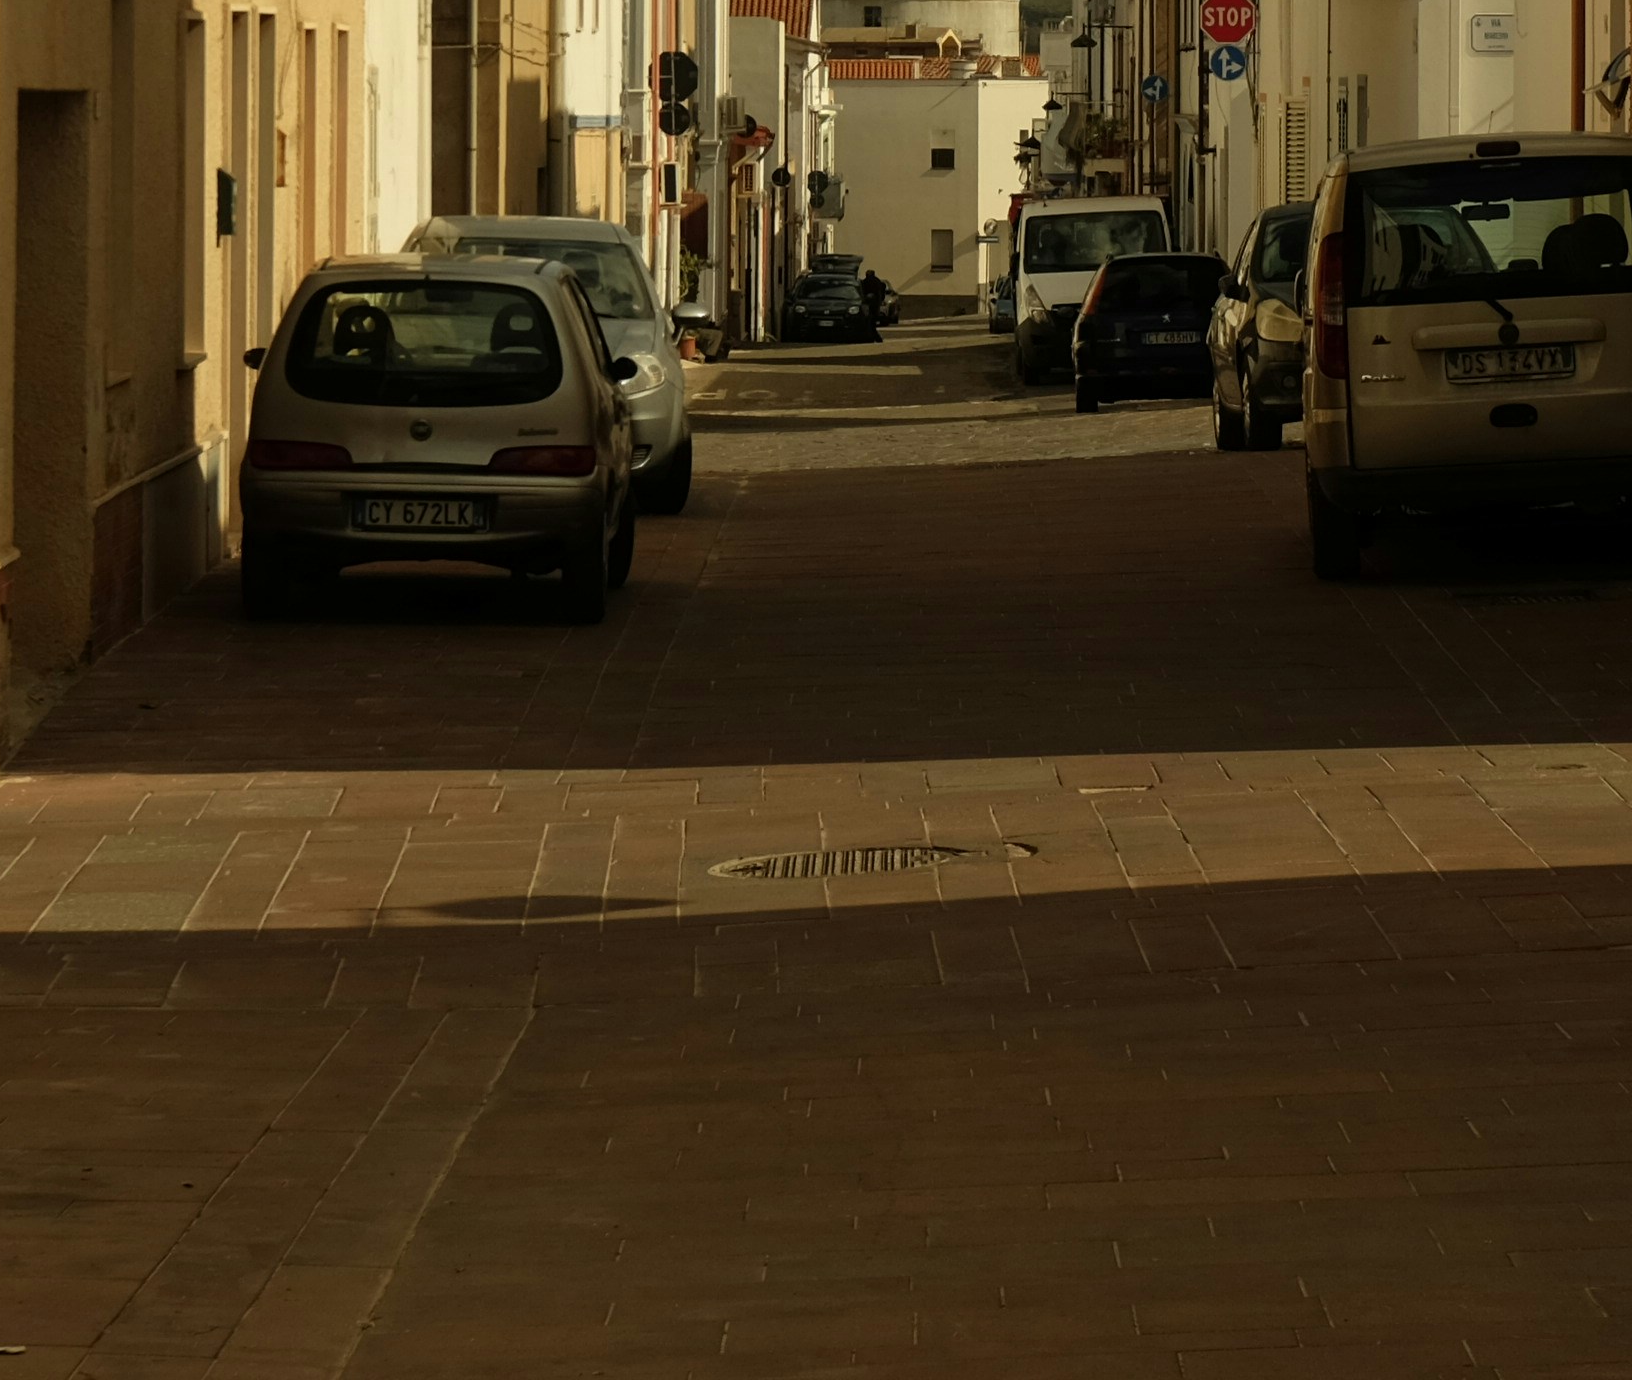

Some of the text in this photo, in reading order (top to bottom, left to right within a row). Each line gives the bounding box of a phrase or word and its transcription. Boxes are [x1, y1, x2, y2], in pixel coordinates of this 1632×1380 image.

[1204, 7, 1251, 27] STOP
[1462, 353, 1486, 374] DS
[369, 502, 469, 525] CY 672LK
